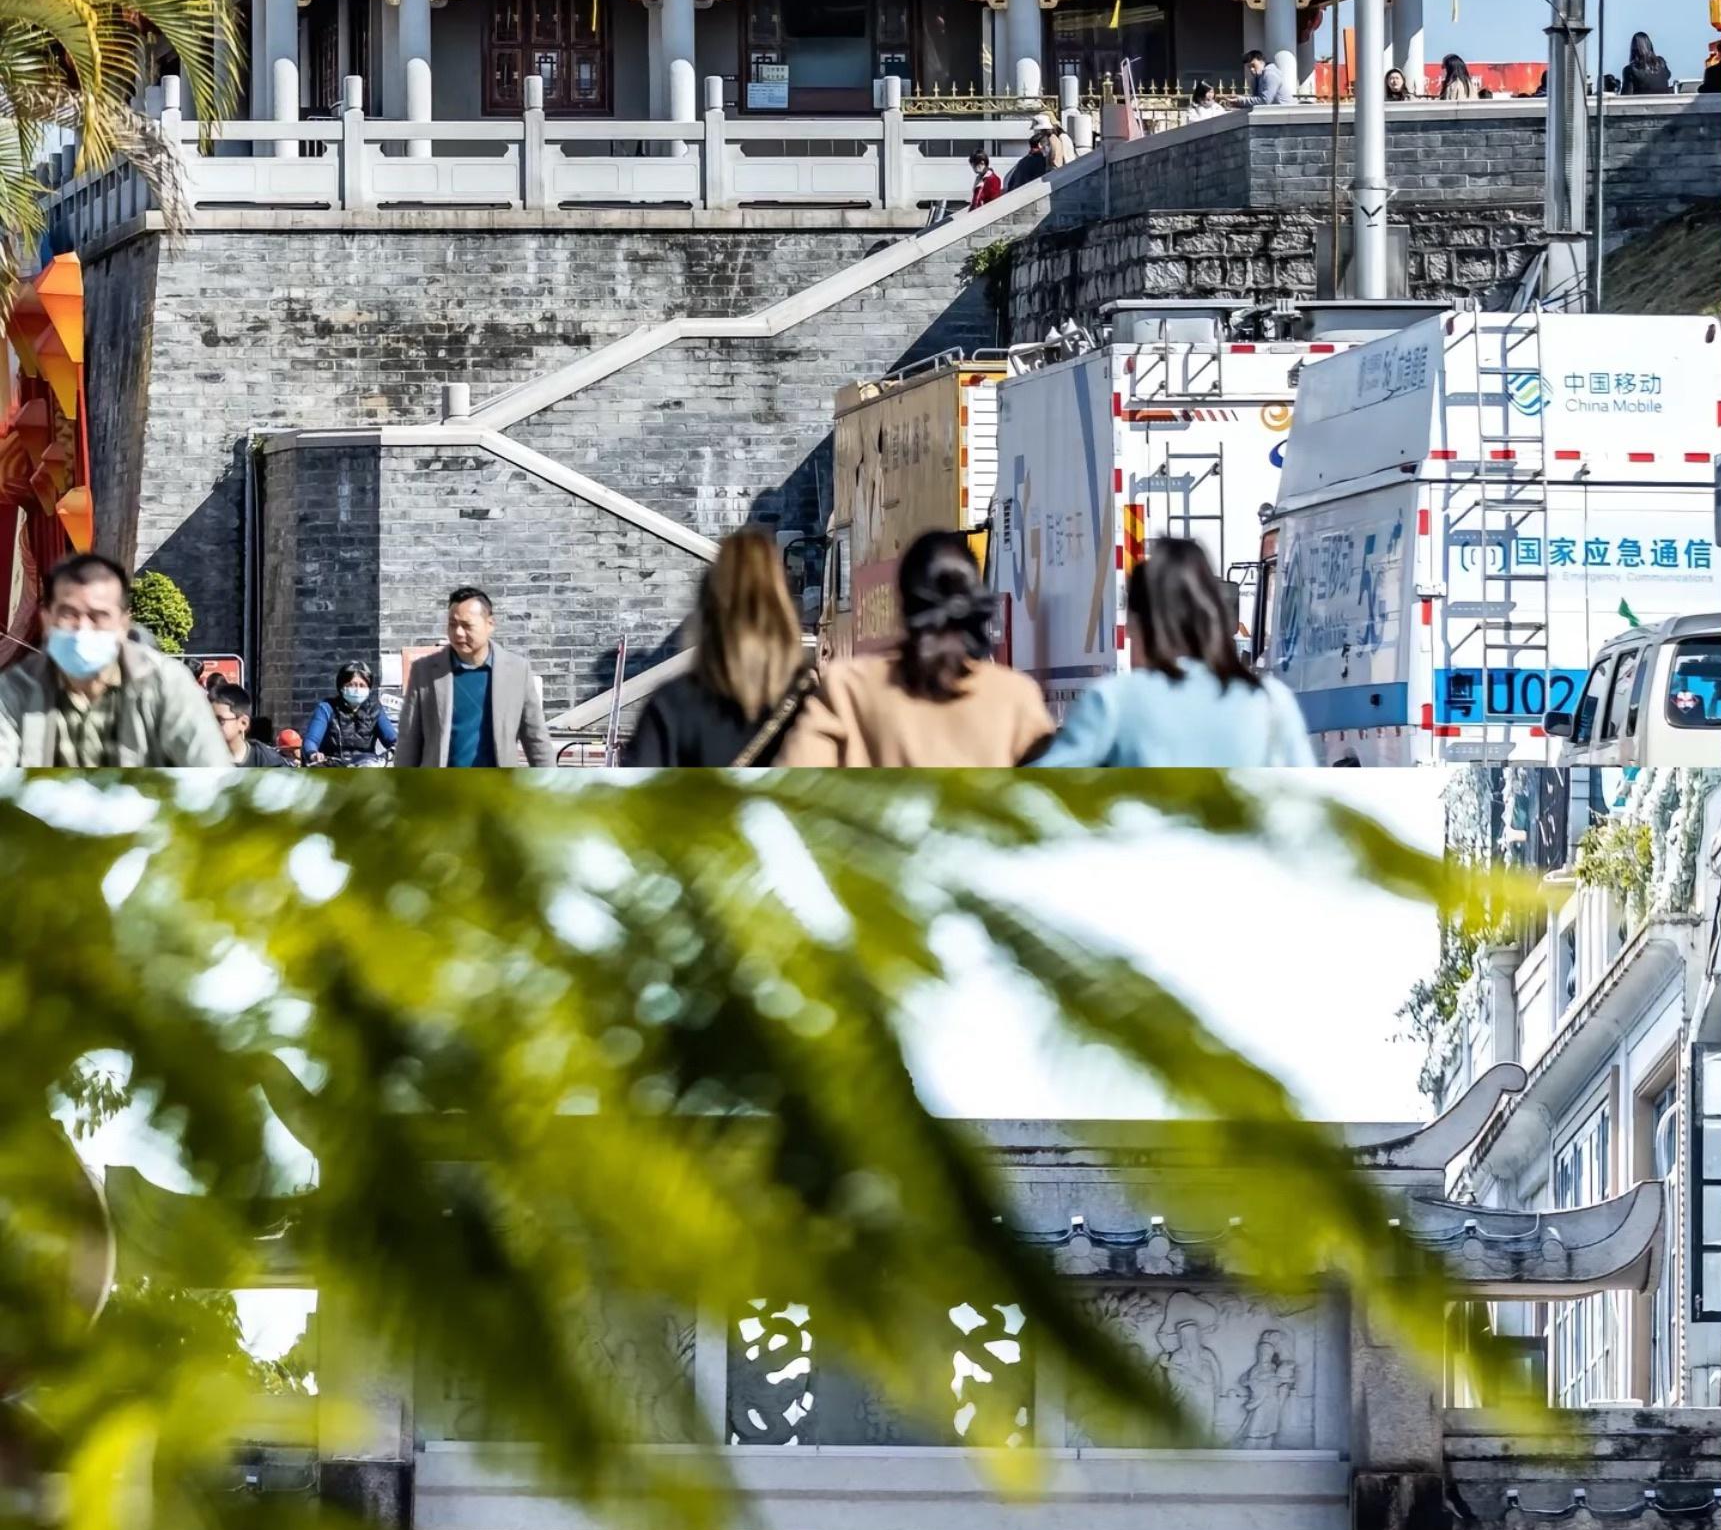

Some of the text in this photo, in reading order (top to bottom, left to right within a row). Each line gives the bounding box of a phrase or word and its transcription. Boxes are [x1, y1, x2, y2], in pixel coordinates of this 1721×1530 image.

[1564, 372, 1662, 395] 中国移动
[1565, 398, 1663, 414] China Mobile
[1514, 537, 1713, 569] 国家应急通信
